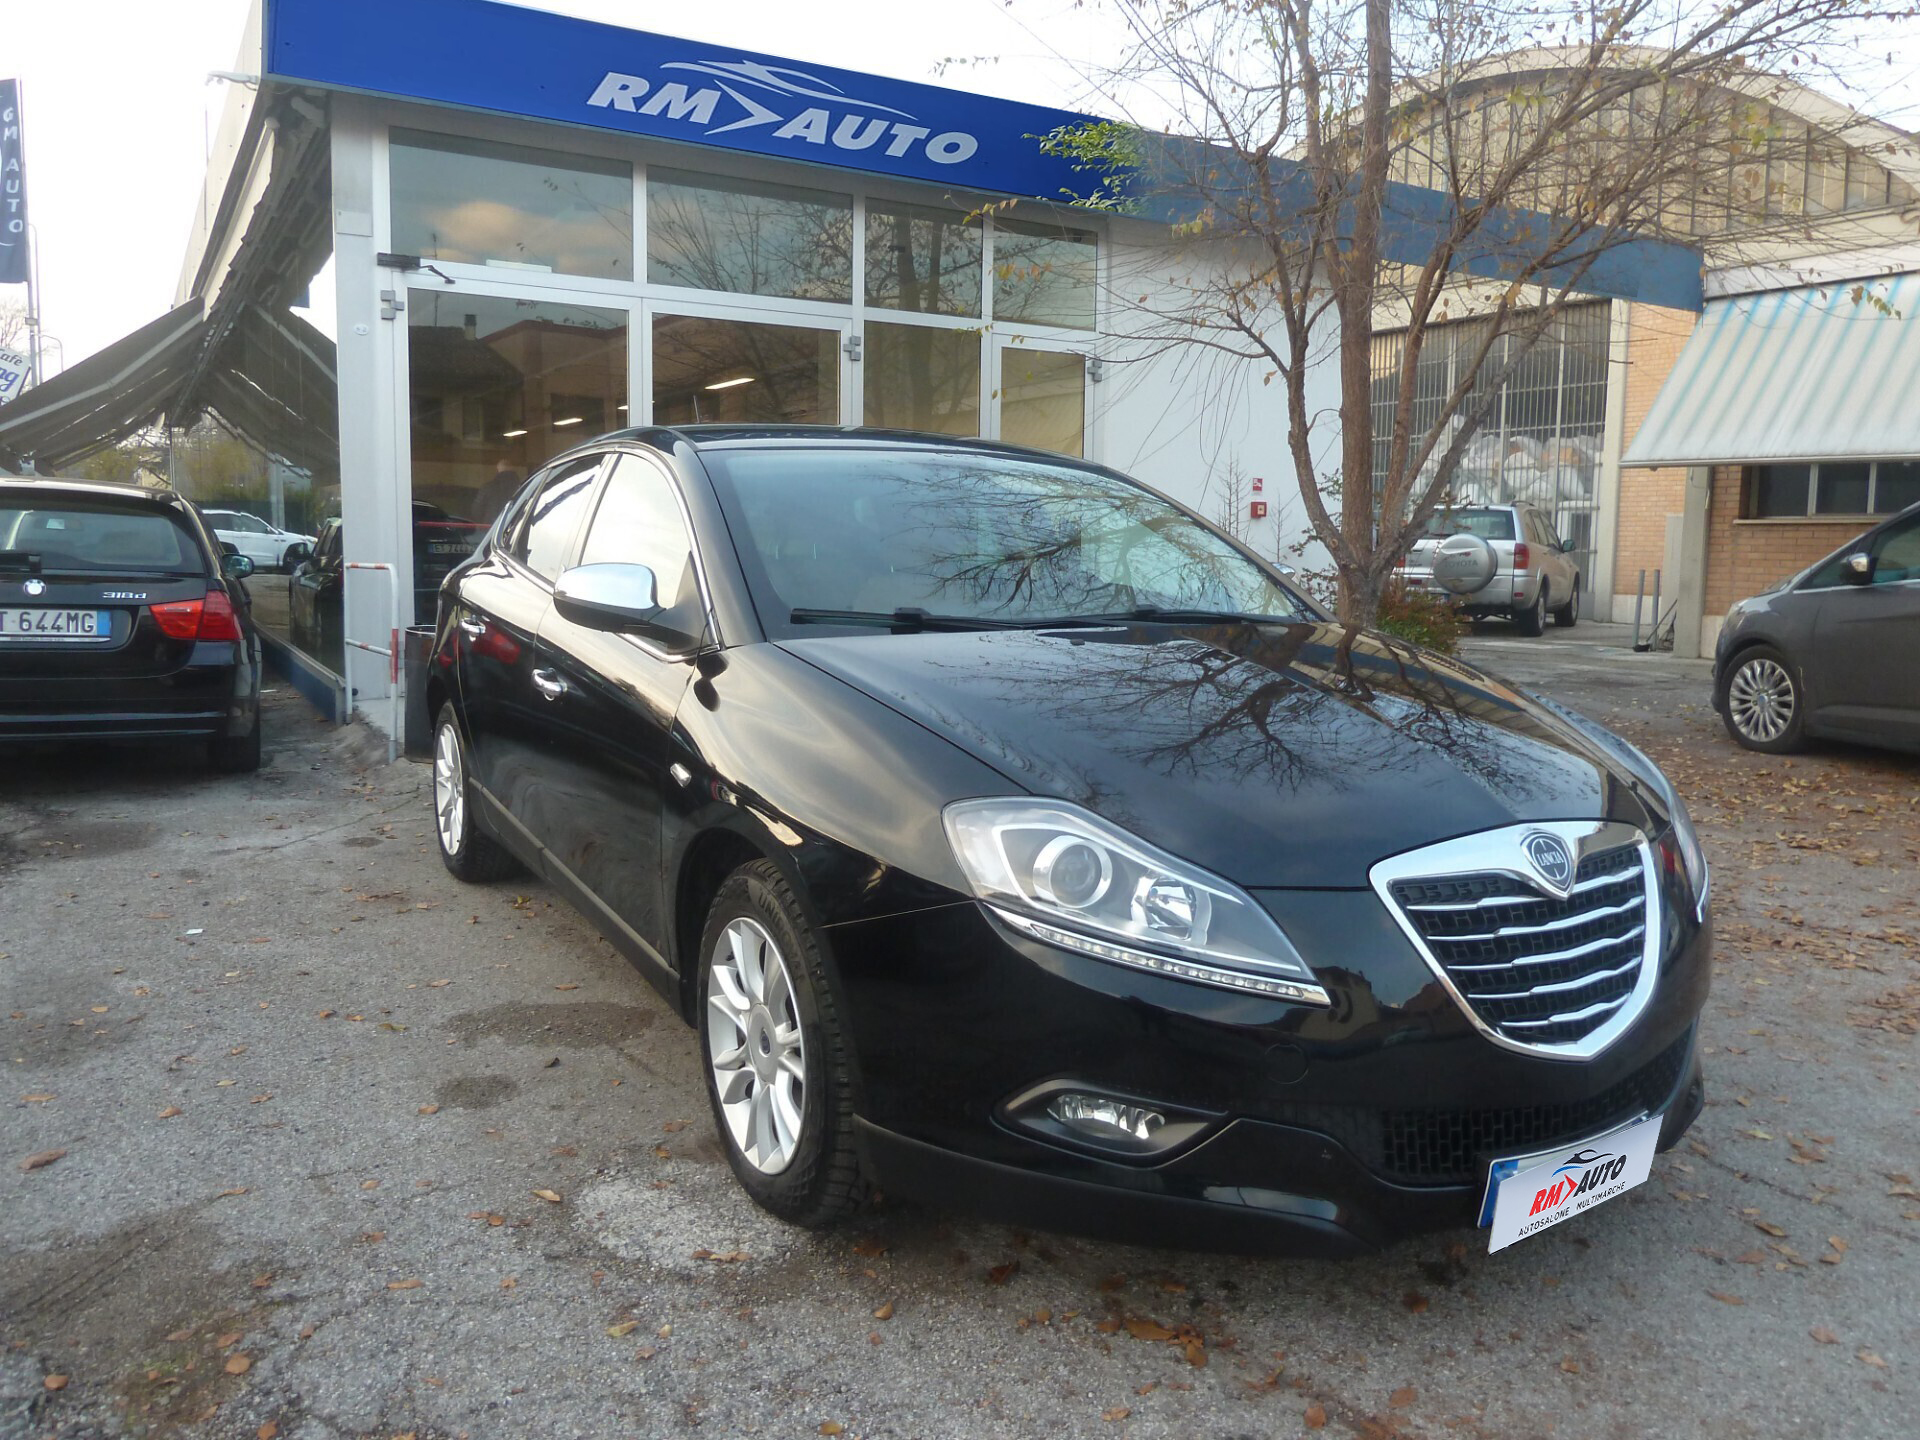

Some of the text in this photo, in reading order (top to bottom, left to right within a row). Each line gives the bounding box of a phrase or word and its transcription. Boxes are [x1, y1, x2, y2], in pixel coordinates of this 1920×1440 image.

[587, 72, 979, 164] RM AUTO
[5, 158, 24, 233] AUTO
[1445, 560, 1478, 568] TOYOTA
[102, 591, 147, 599] 318d
[19, 611, 95, 633] 644MG
[1537, 851, 1565, 867] LANCIA
[1528, 1154, 1627, 1217] RM AUTO
[1518, 1180, 1626, 1238] AUTOSALONE MULTIMARCHE
